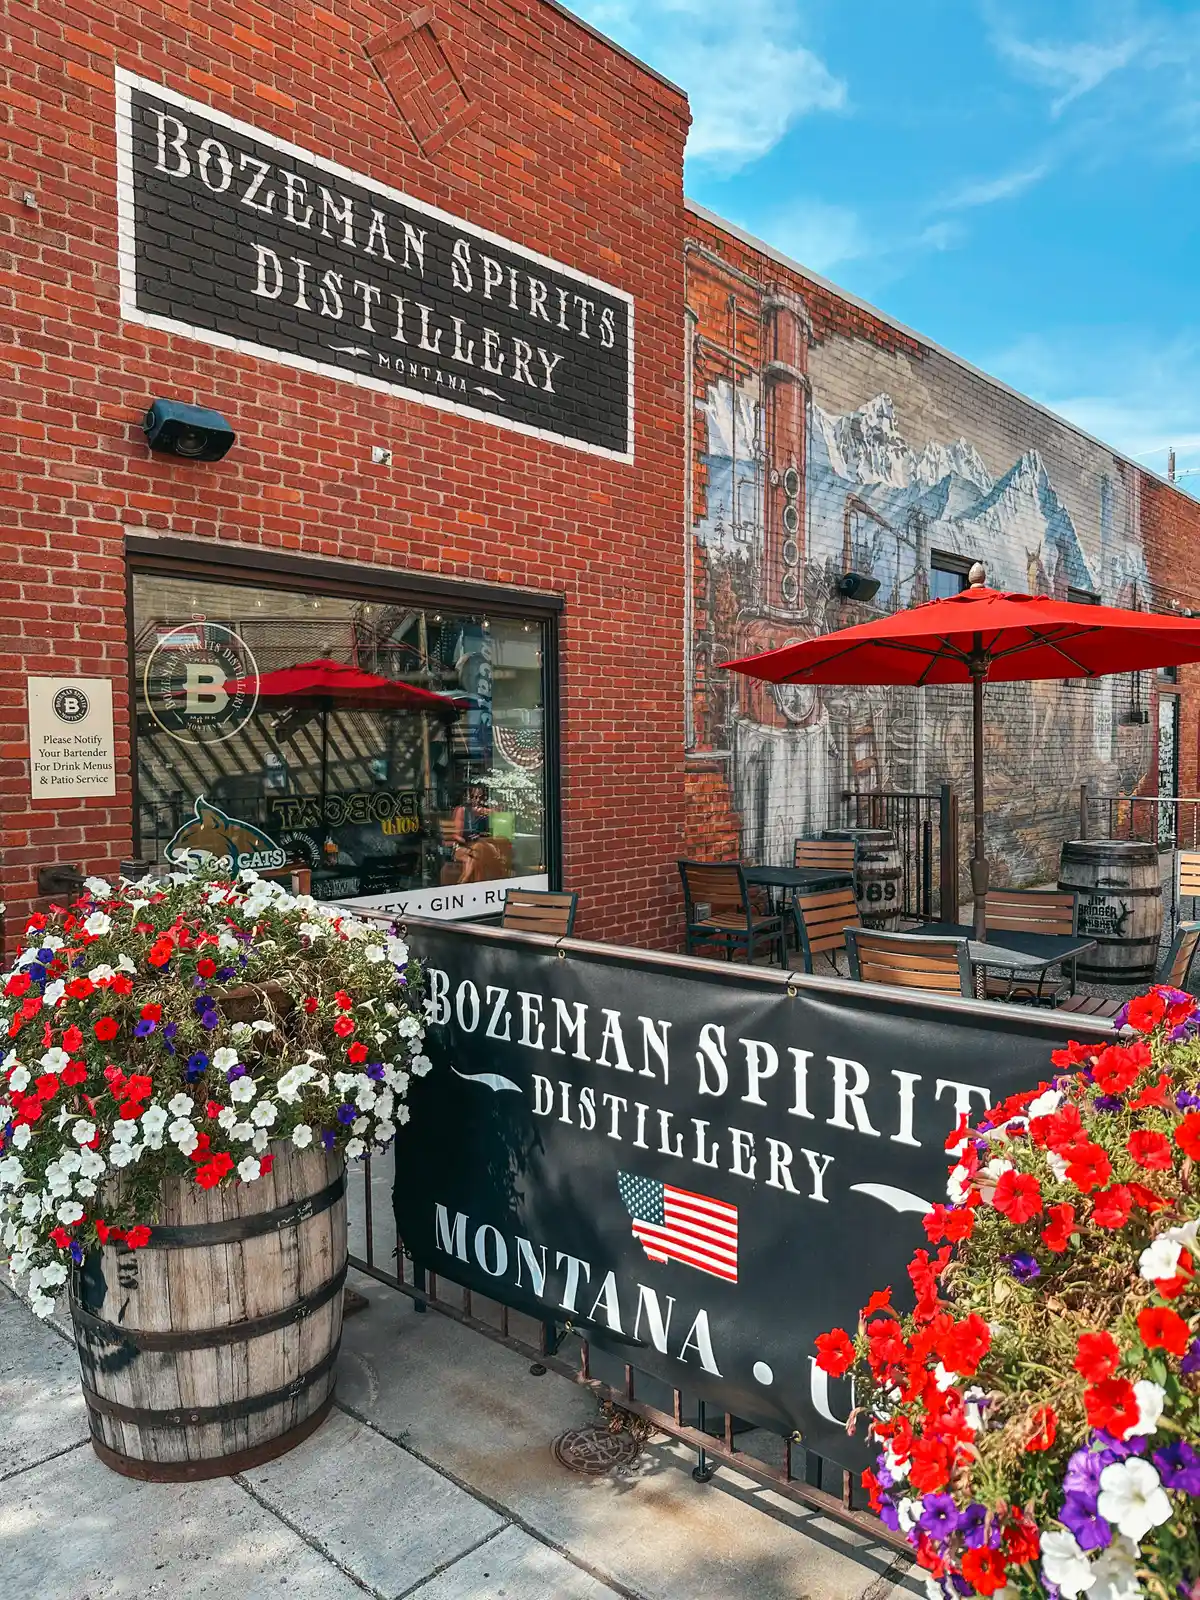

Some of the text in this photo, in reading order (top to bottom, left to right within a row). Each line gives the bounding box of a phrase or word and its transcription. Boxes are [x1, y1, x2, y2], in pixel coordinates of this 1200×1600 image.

[149, 107, 616, 348] BOZEMAN SPIRITS
[250, 242, 565, 394] DISTILLERY
[378, 353, 466, 393] MONTANA
[161, 640, 246, 711] BOZEMAN SPIRITS DISTILLERY
[183, 663, 230, 714] B
[64, 697, 80, 713] B
[38, 748, 108, 758] Your Bartender
[43, 734, 103, 746] Please Notify
[34, 761, 113, 771] For Drink Menus
[40, 774, 109, 784] & Patio Service
[238, 850, 282, 869] CATS
[430, 895, 464, 911] GIN
[1088, 895, 1106, 906] JIM
[426, 967, 673, 1086] BOZEMAN
[531, 1073, 835, 1204] DISTILLERY
[434, 1202, 723, 1378] MONTANA
